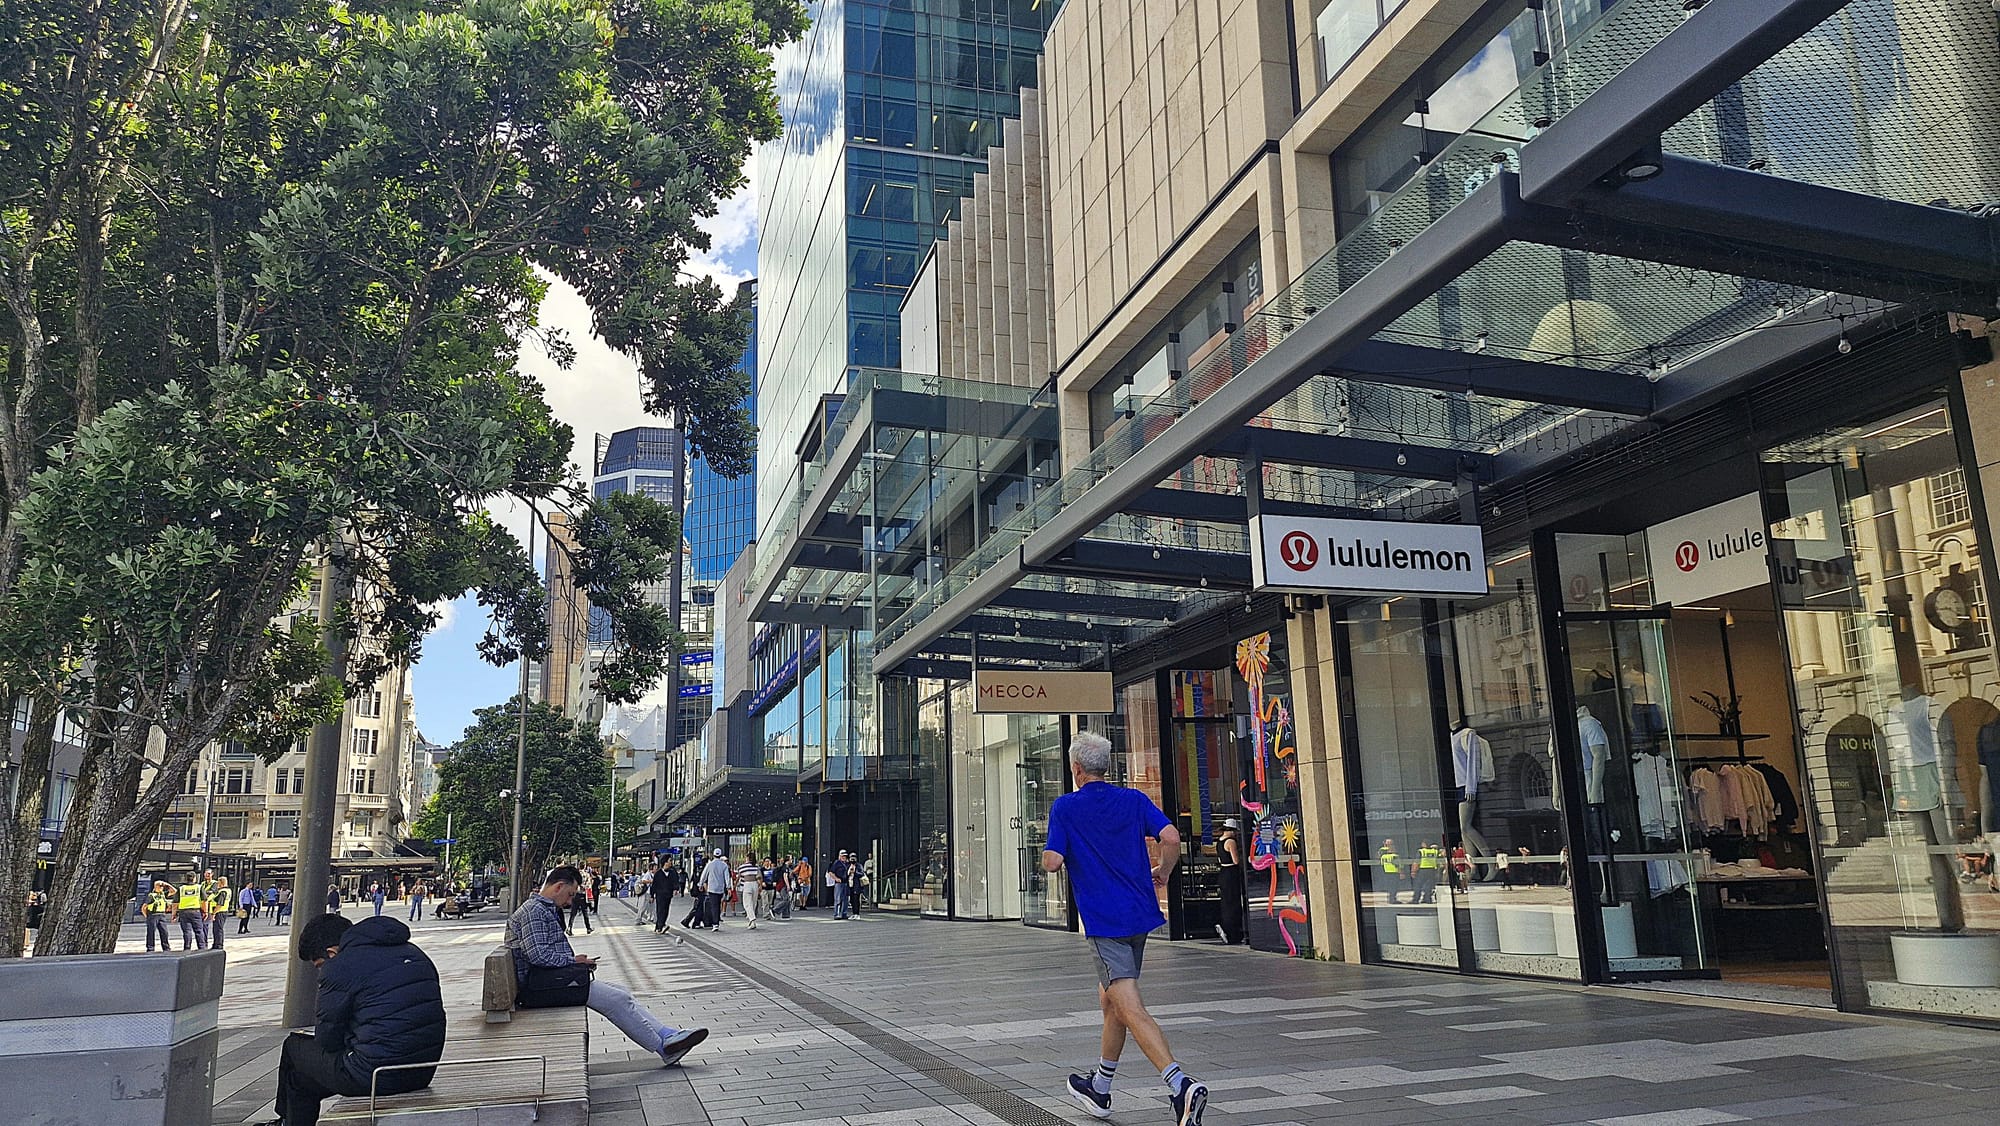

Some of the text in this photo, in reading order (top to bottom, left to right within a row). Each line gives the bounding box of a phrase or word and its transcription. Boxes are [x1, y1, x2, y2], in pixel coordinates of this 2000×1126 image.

[1328, 537, 1471, 571] lululemon
[980, 684, 1047, 698] MECCA
[1839, 737, 1858, 750] NO
